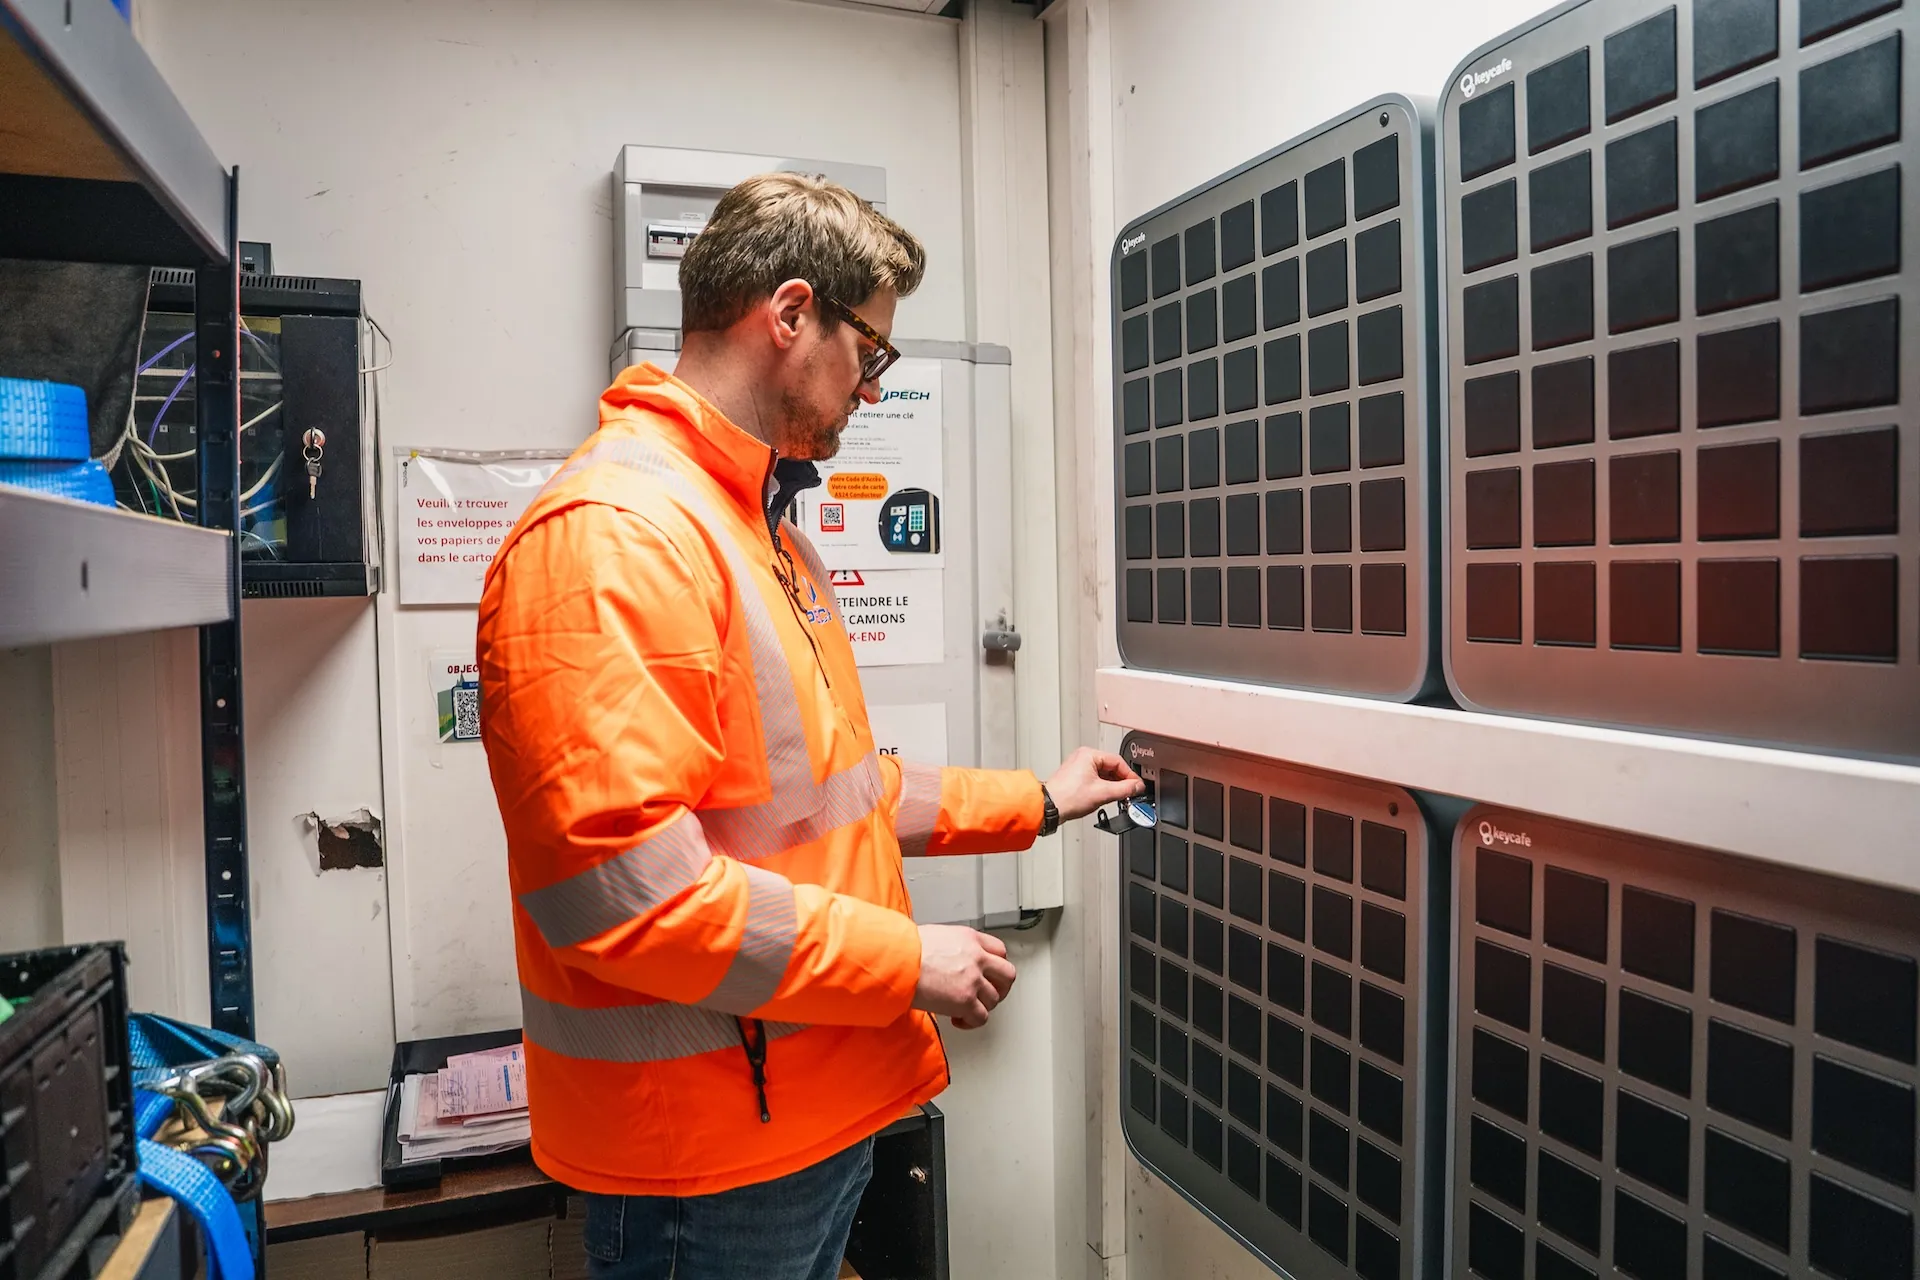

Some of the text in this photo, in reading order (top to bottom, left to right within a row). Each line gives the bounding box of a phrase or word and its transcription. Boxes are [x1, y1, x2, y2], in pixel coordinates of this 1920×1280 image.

[1474, 58, 1512, 85] keycafe
[889, 391, 930, 400] PECH
[902, 411, 914, 419] clé
[466, 499, 508, 509] trouver
[417, 518, 433, 527] les
[437, 518, 503, 530] enveloppes
[418, 536, 437, 545] vos
[441, 534, 483, 547] papiers
[487, 535, 500, 545] de
[418, 552, 445, 562] dans
[449, 552, 459, 562] le
[896, 596, 908, 606] LE
[849, 613, 905, 624] CAMIONS
[849, 631, 886, 642] K-END
[447, 664, 479, 674] OBJEC
[1493, 825, 1532, 847] keycafe
